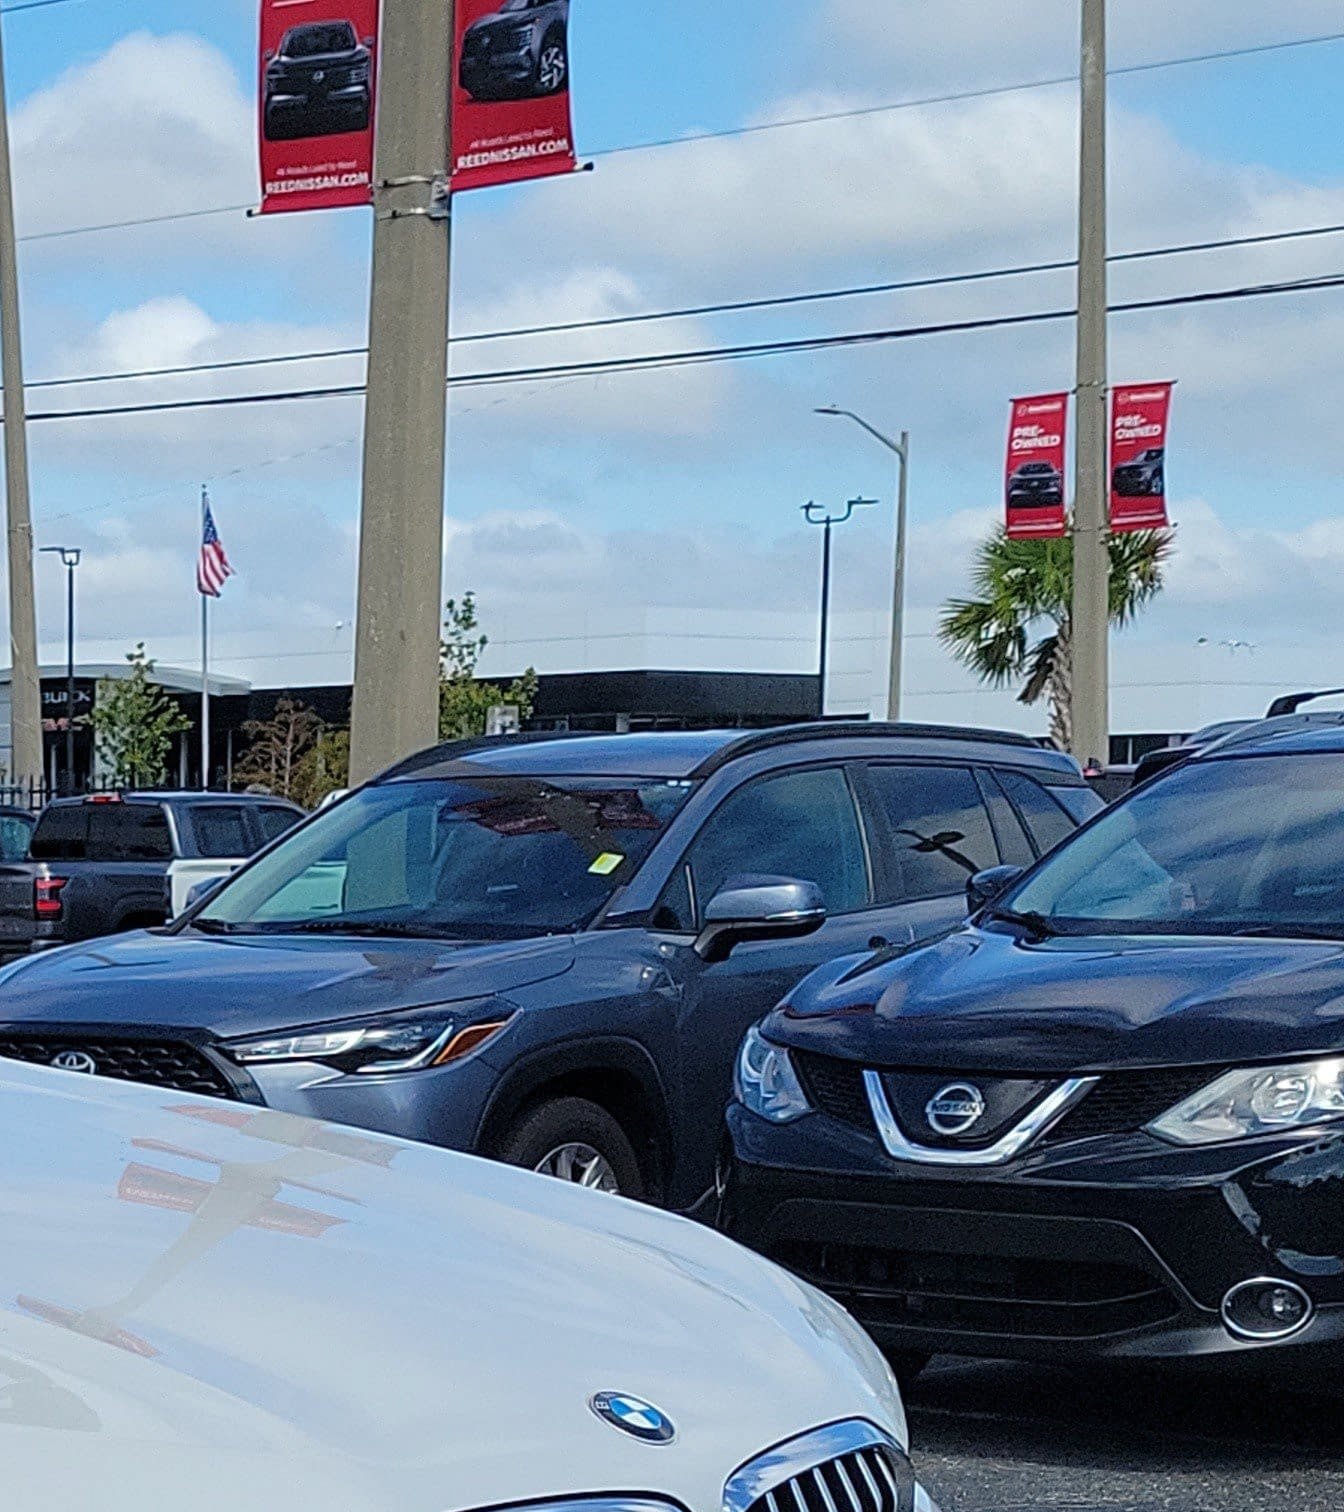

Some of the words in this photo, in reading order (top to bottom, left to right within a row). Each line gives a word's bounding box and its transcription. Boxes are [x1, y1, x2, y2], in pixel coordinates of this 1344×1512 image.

[456, 137, 569, 169] REEDNISSAN.COM
[265, 171, 369, 195] REEDNISSAN.COM
[1115, 414, 1148, 428] PRE-
[1013, 425, 1045, 438] PRE-
[1115, 424, 1162, 440] OWNED
[1011, 434, 1061, 450] OWNED
